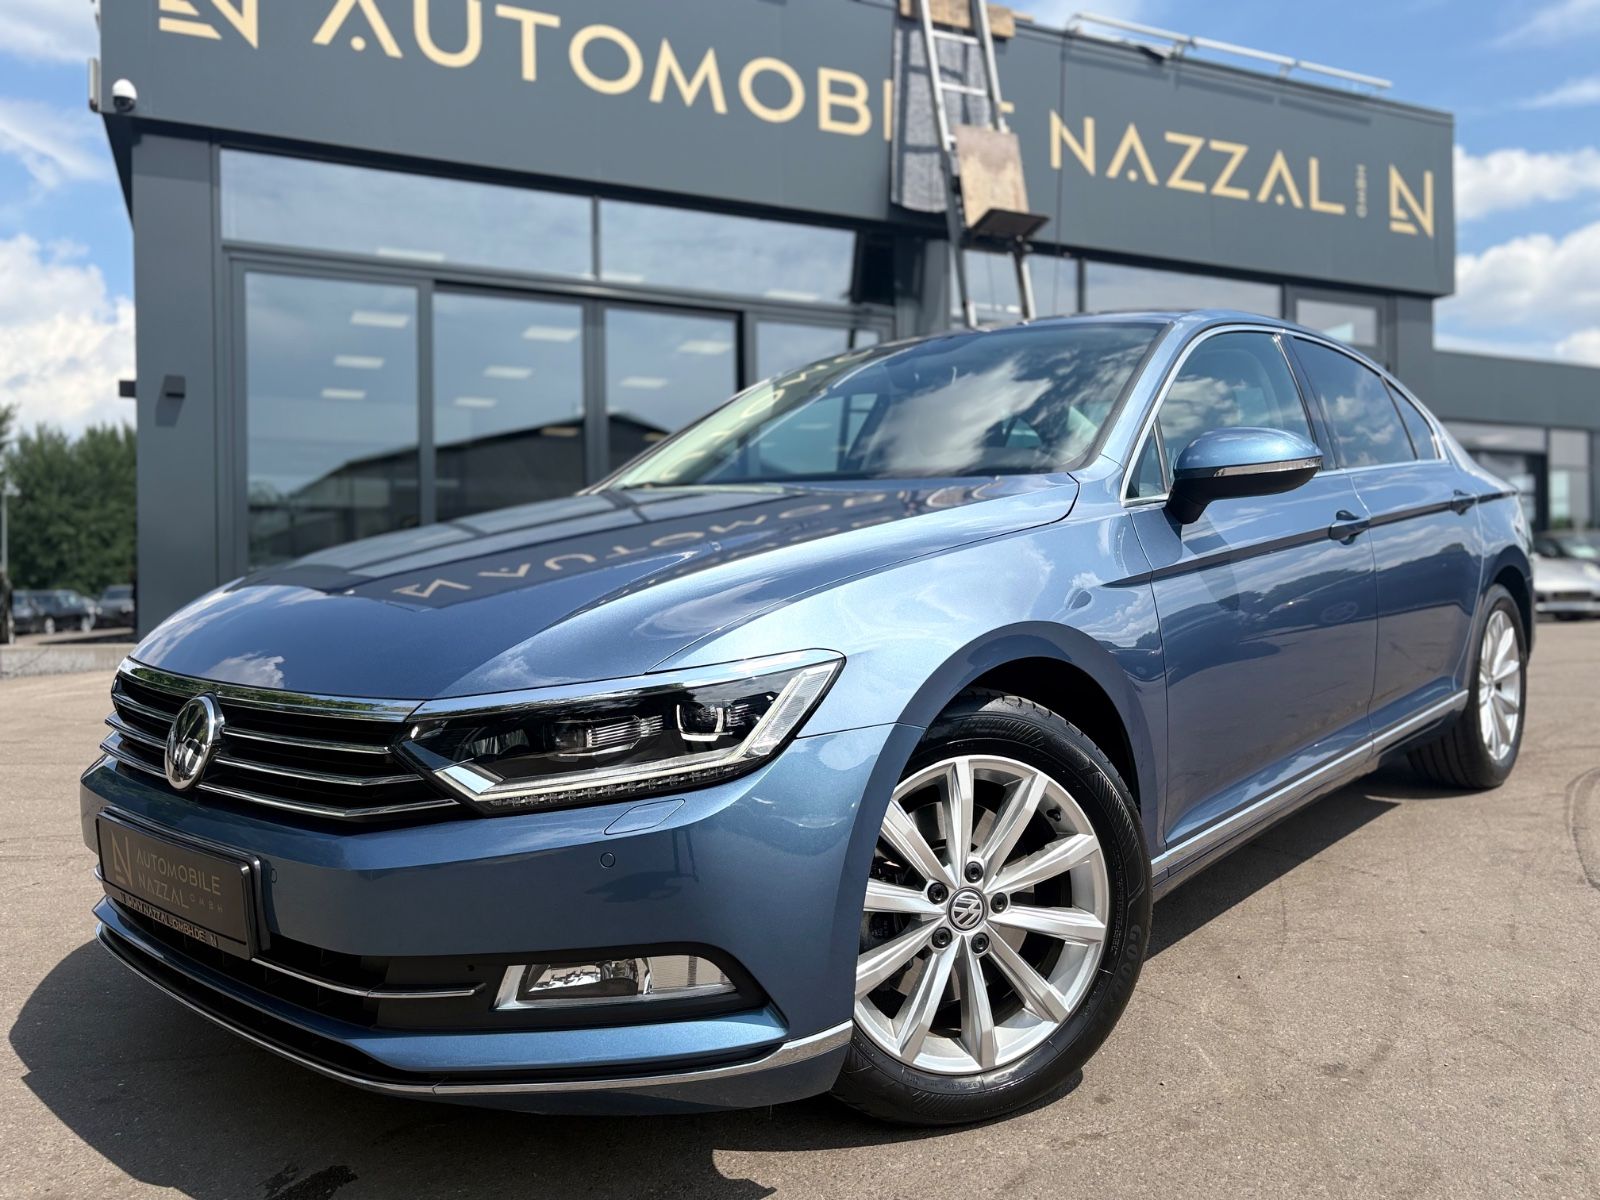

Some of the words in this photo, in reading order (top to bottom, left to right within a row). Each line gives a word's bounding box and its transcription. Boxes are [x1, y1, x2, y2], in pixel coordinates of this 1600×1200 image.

[312, 0, 1014, 142] AUTOMOBI
[1050, 110, 1346, 215] NAZZAL
[136, 848, 222, 896] AUTOMOBILE
[138, 872, 190, 909] NAZZAL
